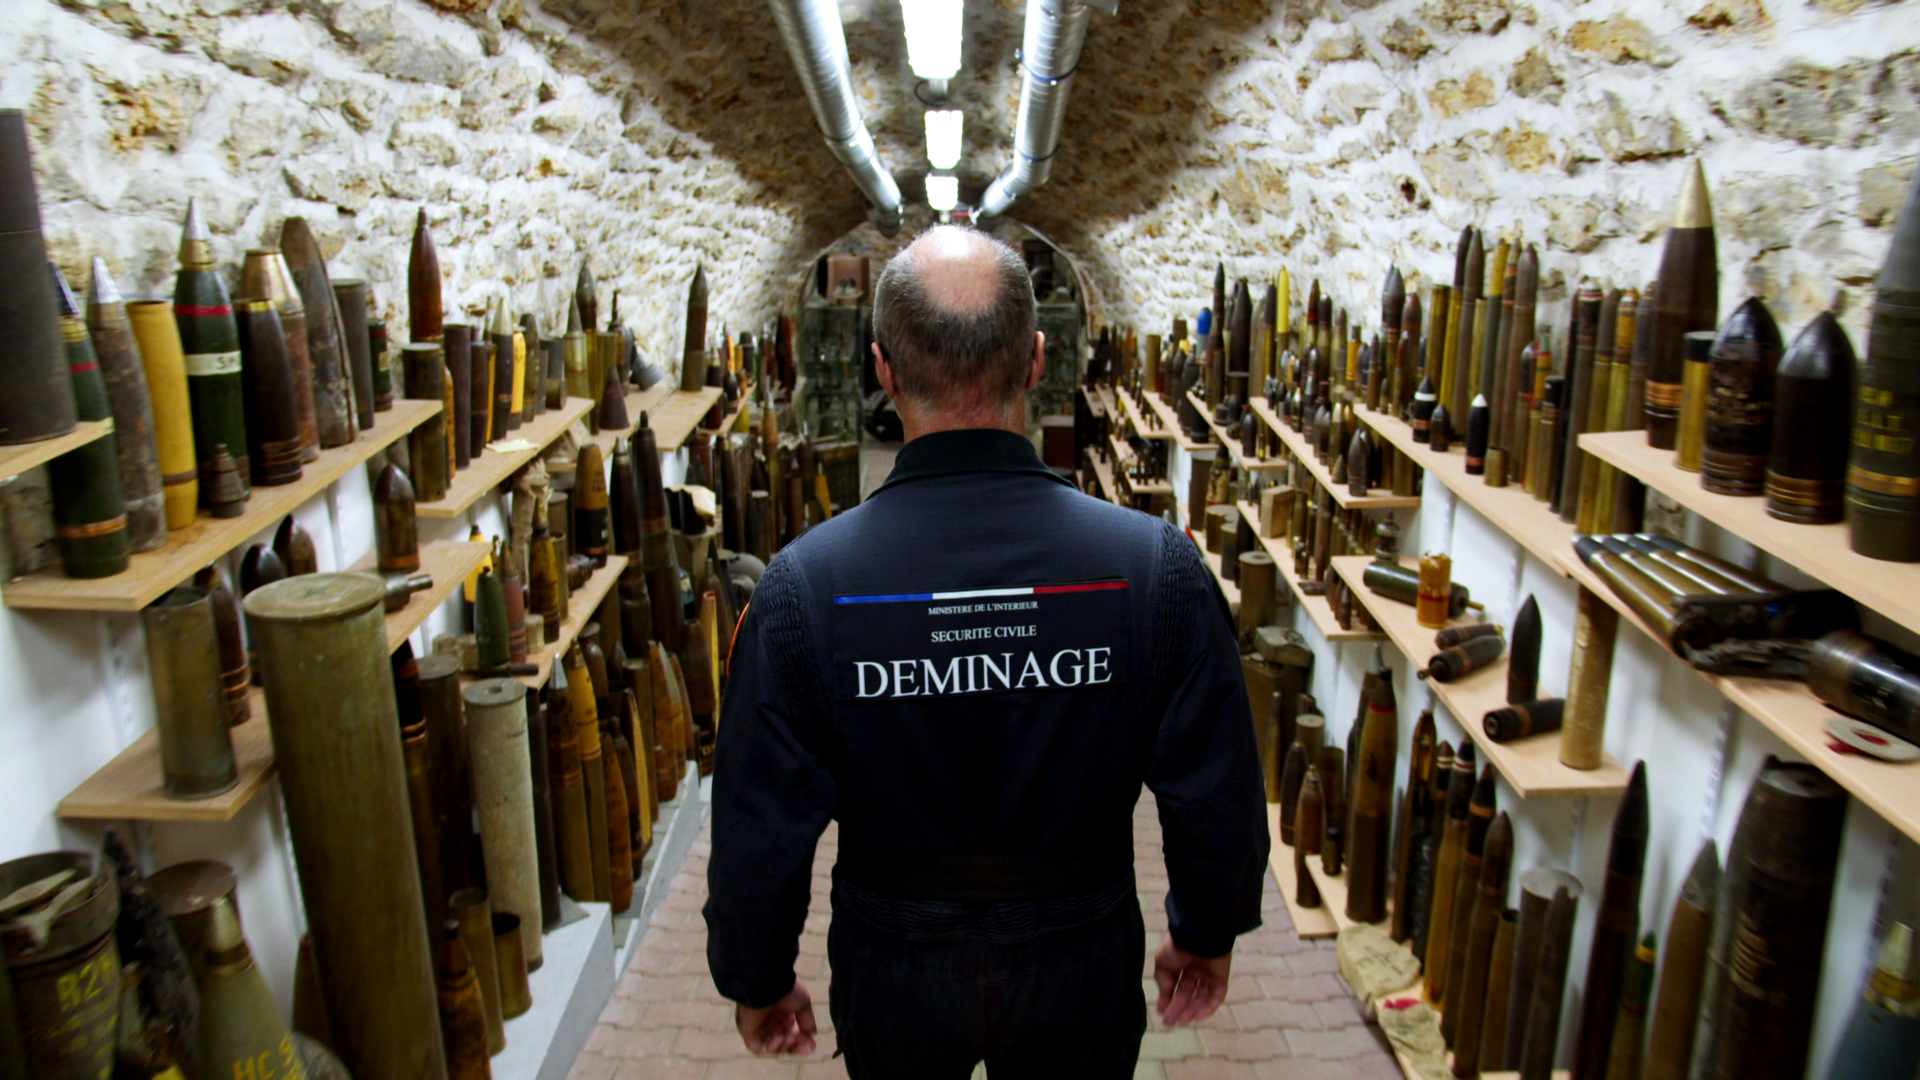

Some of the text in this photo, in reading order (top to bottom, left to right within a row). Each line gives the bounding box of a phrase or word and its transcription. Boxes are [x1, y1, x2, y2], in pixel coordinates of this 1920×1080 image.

[928, 601, 1038, 615] MINISTERE DE L'INTERIEUR
[931, 625, 1037, 642] SECURITE CIVILE
[853, 647, 1112, 698] DEMINAGE
